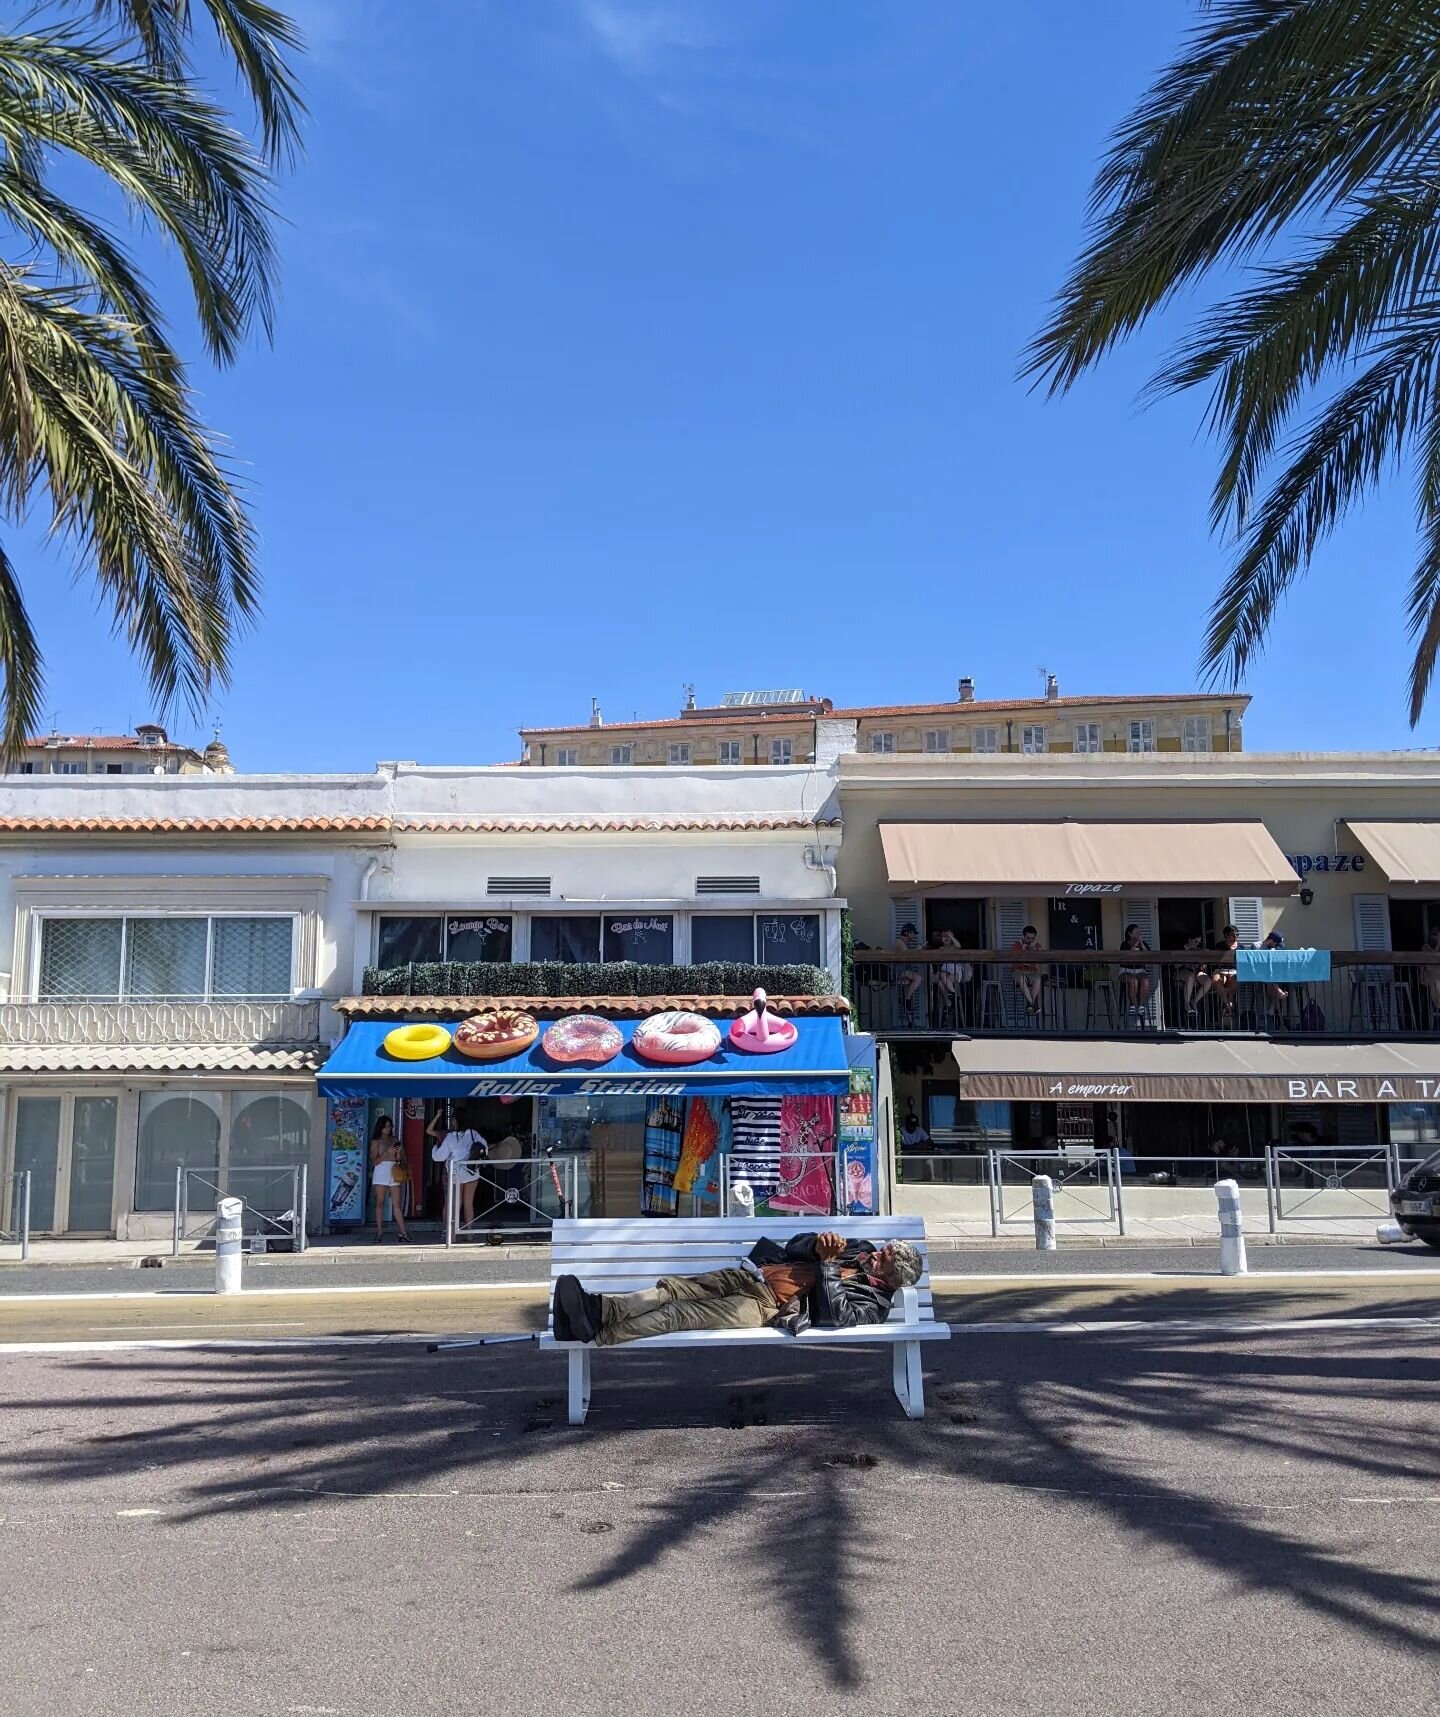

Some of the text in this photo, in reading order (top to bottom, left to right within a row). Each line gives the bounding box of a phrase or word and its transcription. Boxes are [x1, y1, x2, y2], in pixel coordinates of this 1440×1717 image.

[1065, 884, 1122, 895] Topaze
[486, 917, 509, 933] Bar
[610, 922, 633, 934] Bar
[633, 917, 643, 930] de
[468, 1079, 687, 1096] Roller Station
[1049, 1081, 1133, 1098] A emporter
[1288, 1080, 1359, 1098] BAR
[1376, 1080, 1399, 1098] A
